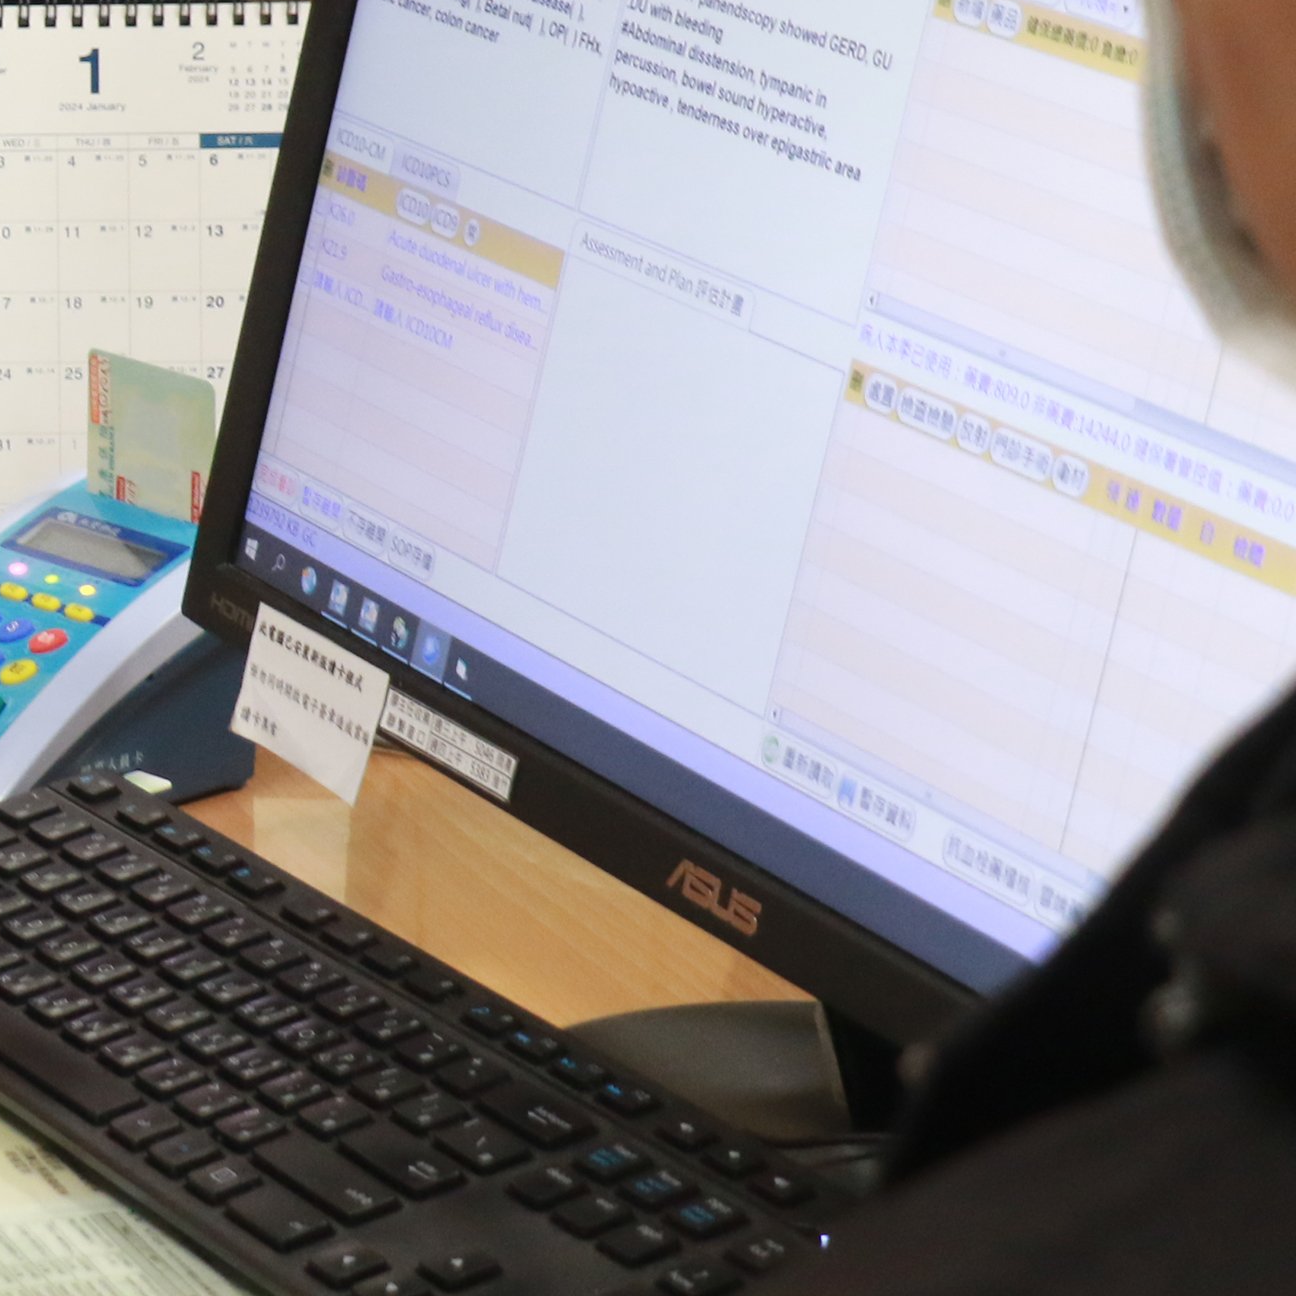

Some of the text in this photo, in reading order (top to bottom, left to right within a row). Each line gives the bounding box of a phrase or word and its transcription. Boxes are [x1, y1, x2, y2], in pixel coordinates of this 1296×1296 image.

[435, 6, 500, 44] colon cancer
[649, 2, 725, 45] with bleeding
[193, 43, 204, 61] 2
[621, 19, 688, 55] #Abdominal
[759, 70, 815, 104] tympanic
[779, 19, 827, 50] showed
[872, 49, 894, 71] GU
[79, 48, 100, 94] 1
[179, 65, 219, 74] February
[59, 102, 126, 112] 2024 January
[681, 69, 717, 98] bowel
[718, 87, 755, 112] sound
[217, 136, 237, 146] SAT
[609, 71, 669, 109] hypoactive
[676, 97, 741, 137] tenderness
[742, 123, 770, 147] over
[834, 158, 862, 183] area
[67, 155, 76, 167] 4
[139, 155, 147, 166] 5
[210, 154, 219, 166] 6
[65, 227, 80, 238] 11
[136, 226, 152, 238] 12
[207, 226, 224, 237] 13
[580, 231, 644, 273] Assessment
[644, 261, 668, 283] and
[668, 267, 693, 295] Plan
[65, 297, 82, 309] 18
[137, 296, 154, 309] 19
[206, 295, 225, 308] 20
[64, 367, 83, 380] 25
[207, 366, 225, 379] 27
[666, 857, 763, 937] ASUS
